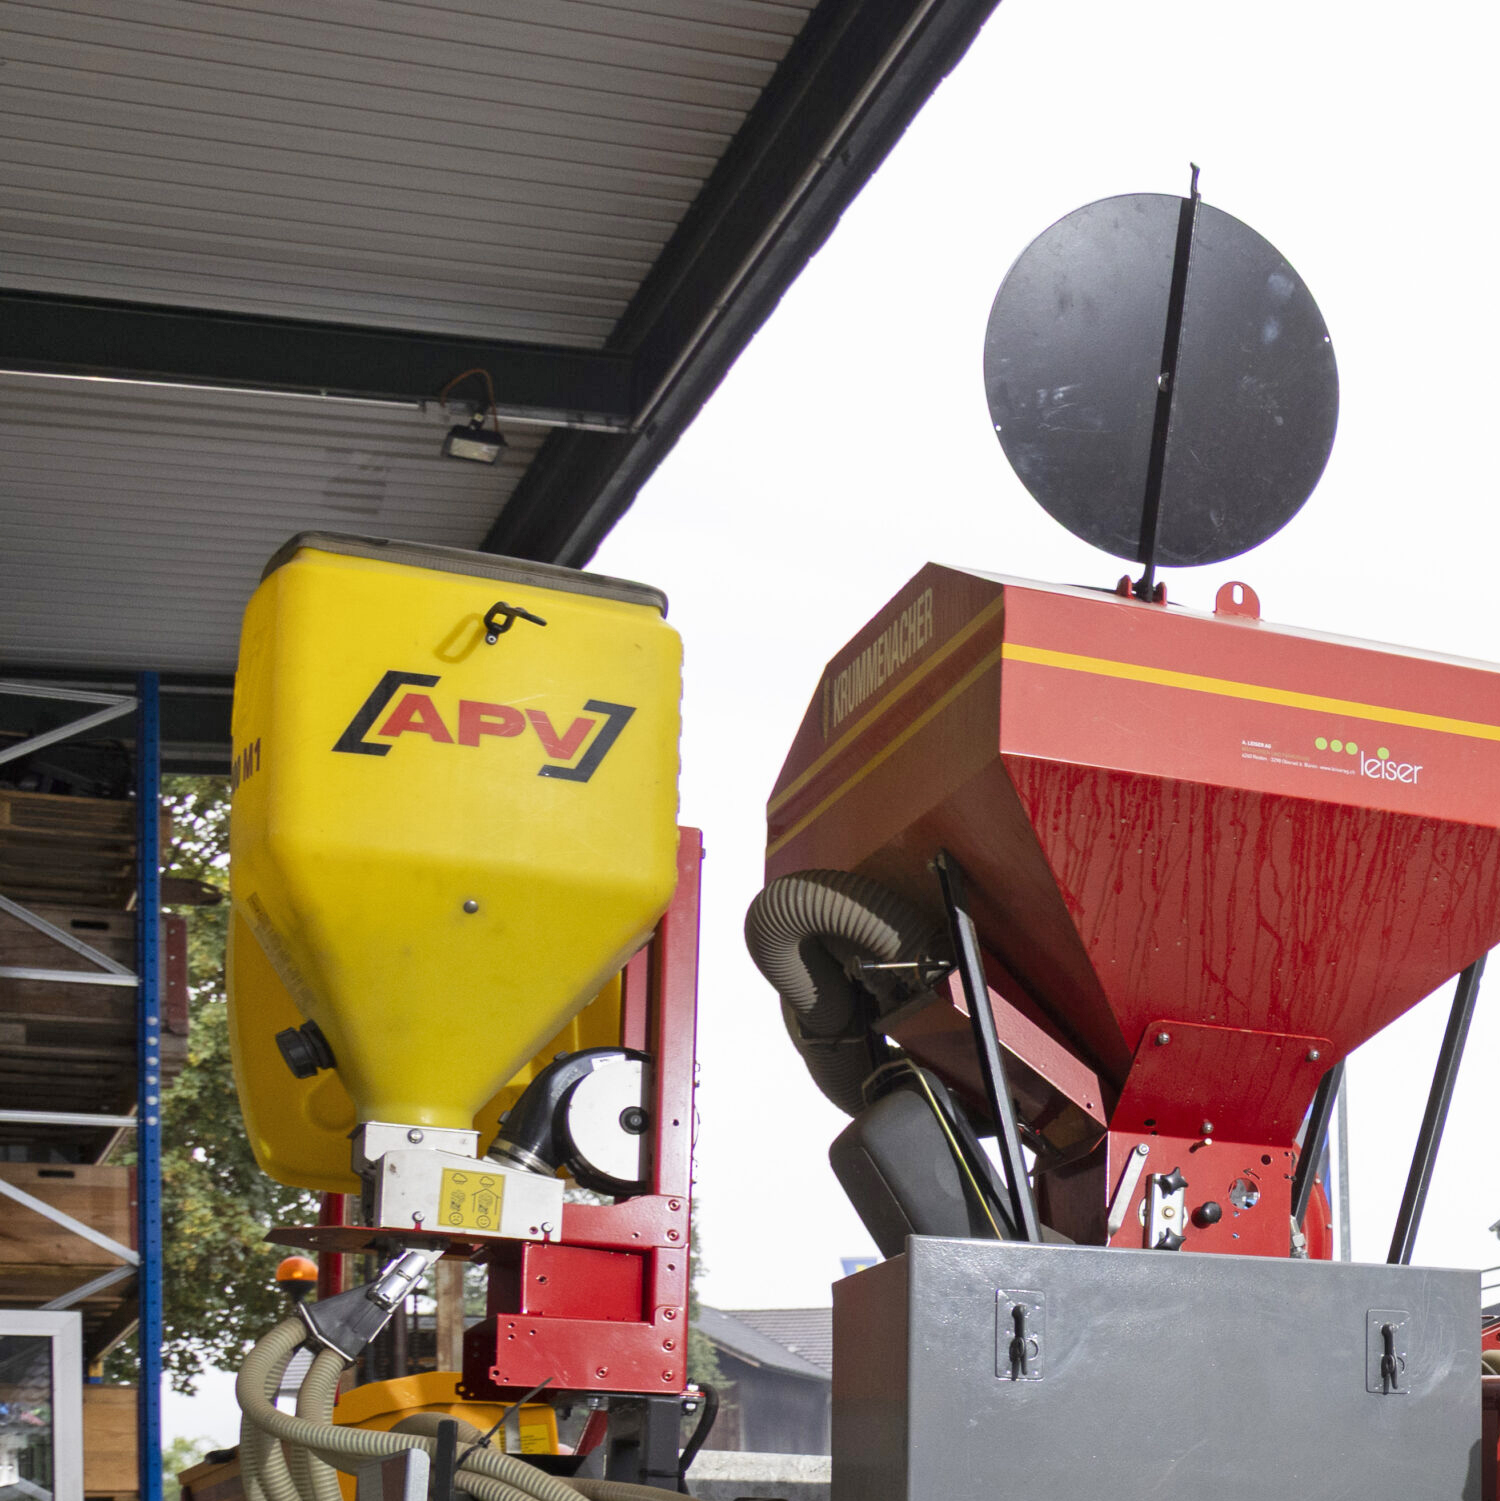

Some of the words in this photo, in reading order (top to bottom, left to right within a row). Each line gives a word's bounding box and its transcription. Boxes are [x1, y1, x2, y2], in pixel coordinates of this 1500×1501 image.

[833, 586, 934, 728] KRUMMENACHER
[377, 692, 598, 761] APV
[1360, 746, 1424, 785] leiser
